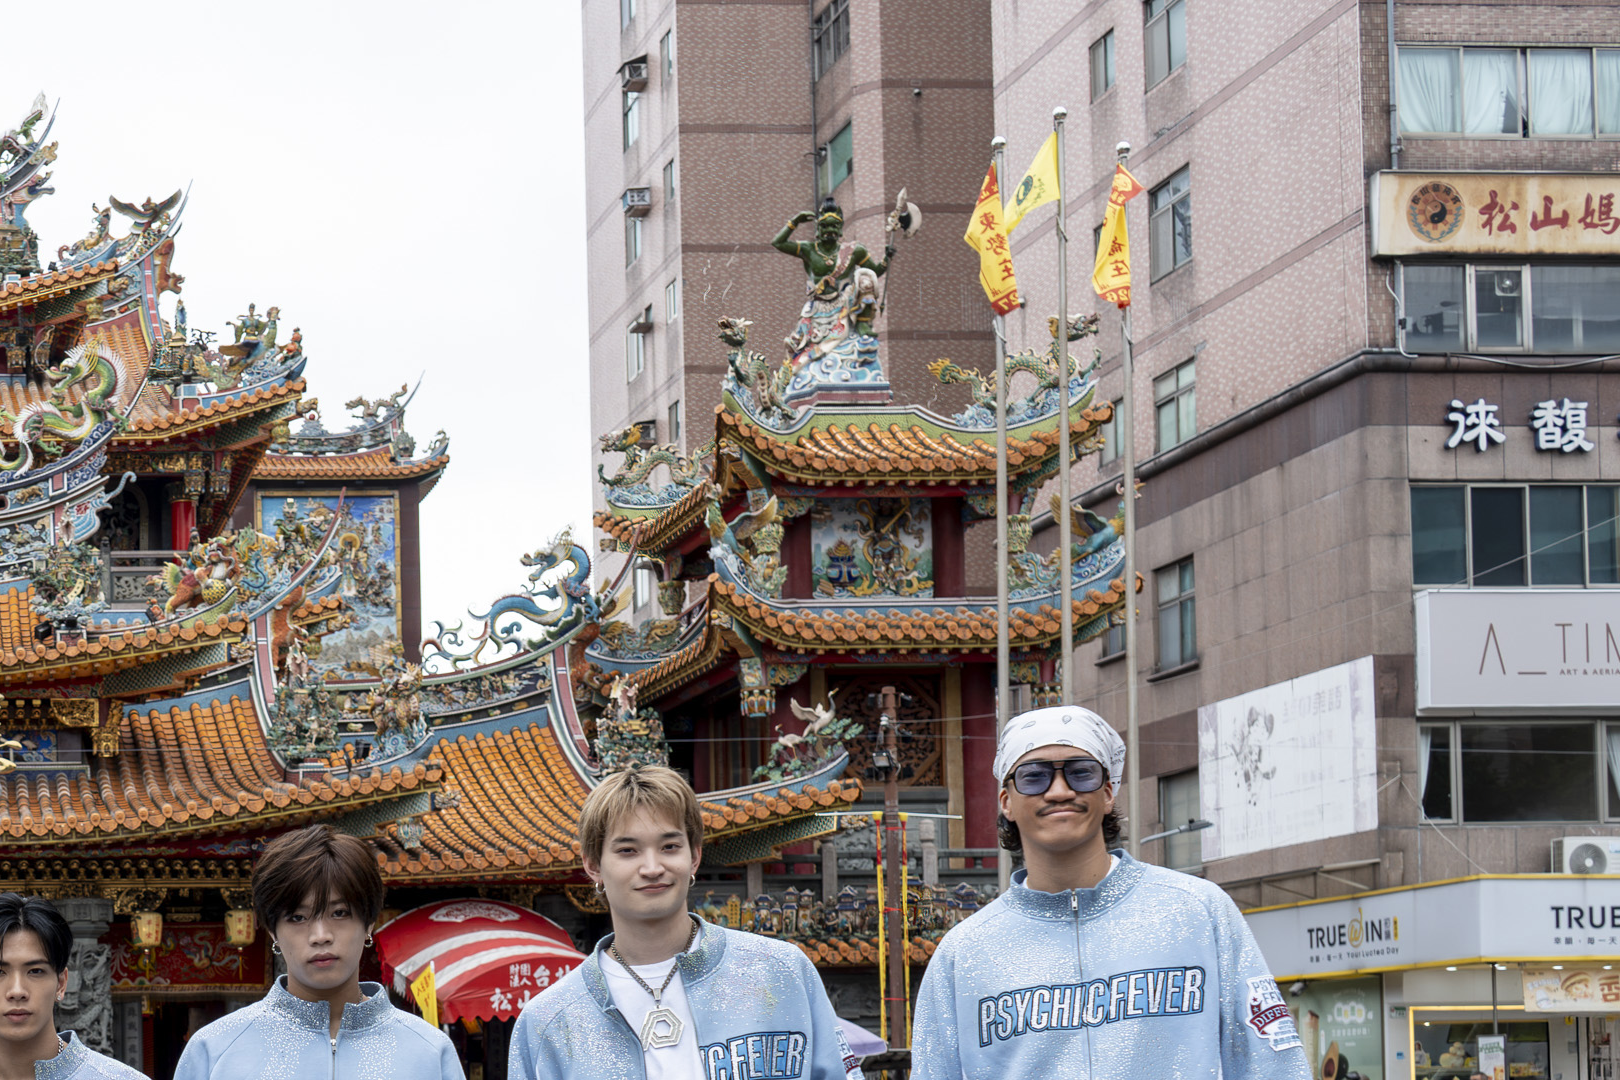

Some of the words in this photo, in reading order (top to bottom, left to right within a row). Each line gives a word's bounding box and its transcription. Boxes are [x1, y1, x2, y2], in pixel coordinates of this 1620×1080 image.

[1478, 189, 1620, 236] 松山媽
[1386, 946, 1399, 955] Day
